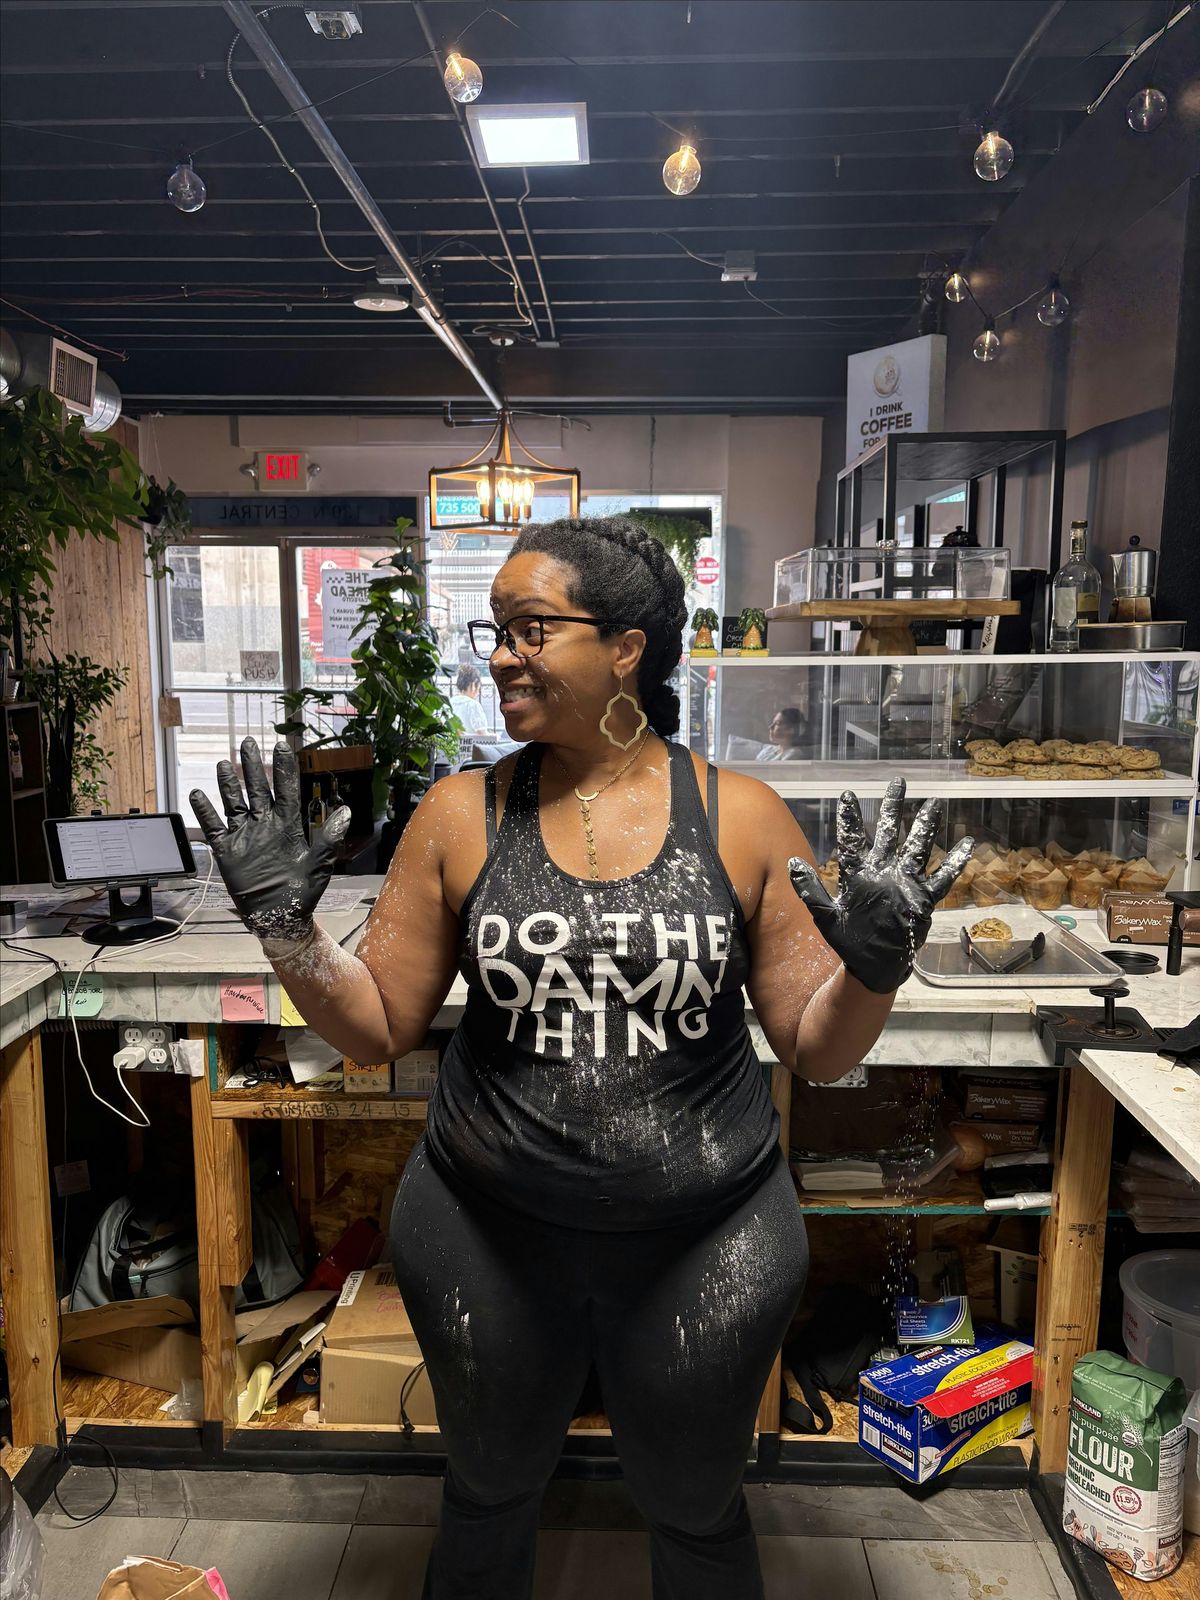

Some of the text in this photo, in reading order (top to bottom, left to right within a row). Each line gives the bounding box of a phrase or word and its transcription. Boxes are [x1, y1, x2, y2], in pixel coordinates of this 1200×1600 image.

[869, 402, 904, 417] I DRINK
[860, 412, 912, 436] COFFEE
[266, 455, 300, 481] EXIT
[440, 502, 458, 513] 735
[244, 667, 277, 681] PUSH
[1113, 914, 1162, 926] BakeryWax
[477, 911, 729, 961] DO THE
[478, 953, 727, 1012] DAMN
[506, 1006, 709, 1058] THING
[969, 1093, 1011, 1105] BakeryWax
[911, 1346, 981, 1377] stretch-tite
[916, 1345, 944, 1360] KIRKLAND
[867, 1367, 892, 1380] 3000
[950, 1390, 1018, 1434] stretch-tite
[1072, 1396, 1102, 1418] KIRKLAND
[862, 1404, 913, 1441] stretch-tite
[921, 1413, 939, 1428] 300
[884, 1436, 913, 1459] KIRKLAND
[953, 1446, 980, 1466] PLASTIC
[980, 1438, 999, 1454] FOOD
[999, 1427, 1019, 1444] WRAP
[1069, 1420, 1135, 1482] FLOUR
[1068, 1454, 1095, 1482] ORGANIC
[1067, 1466, 1111, 1503] UNBLEACHED
[1116, 1494, 1139, 1505] 11.5%
